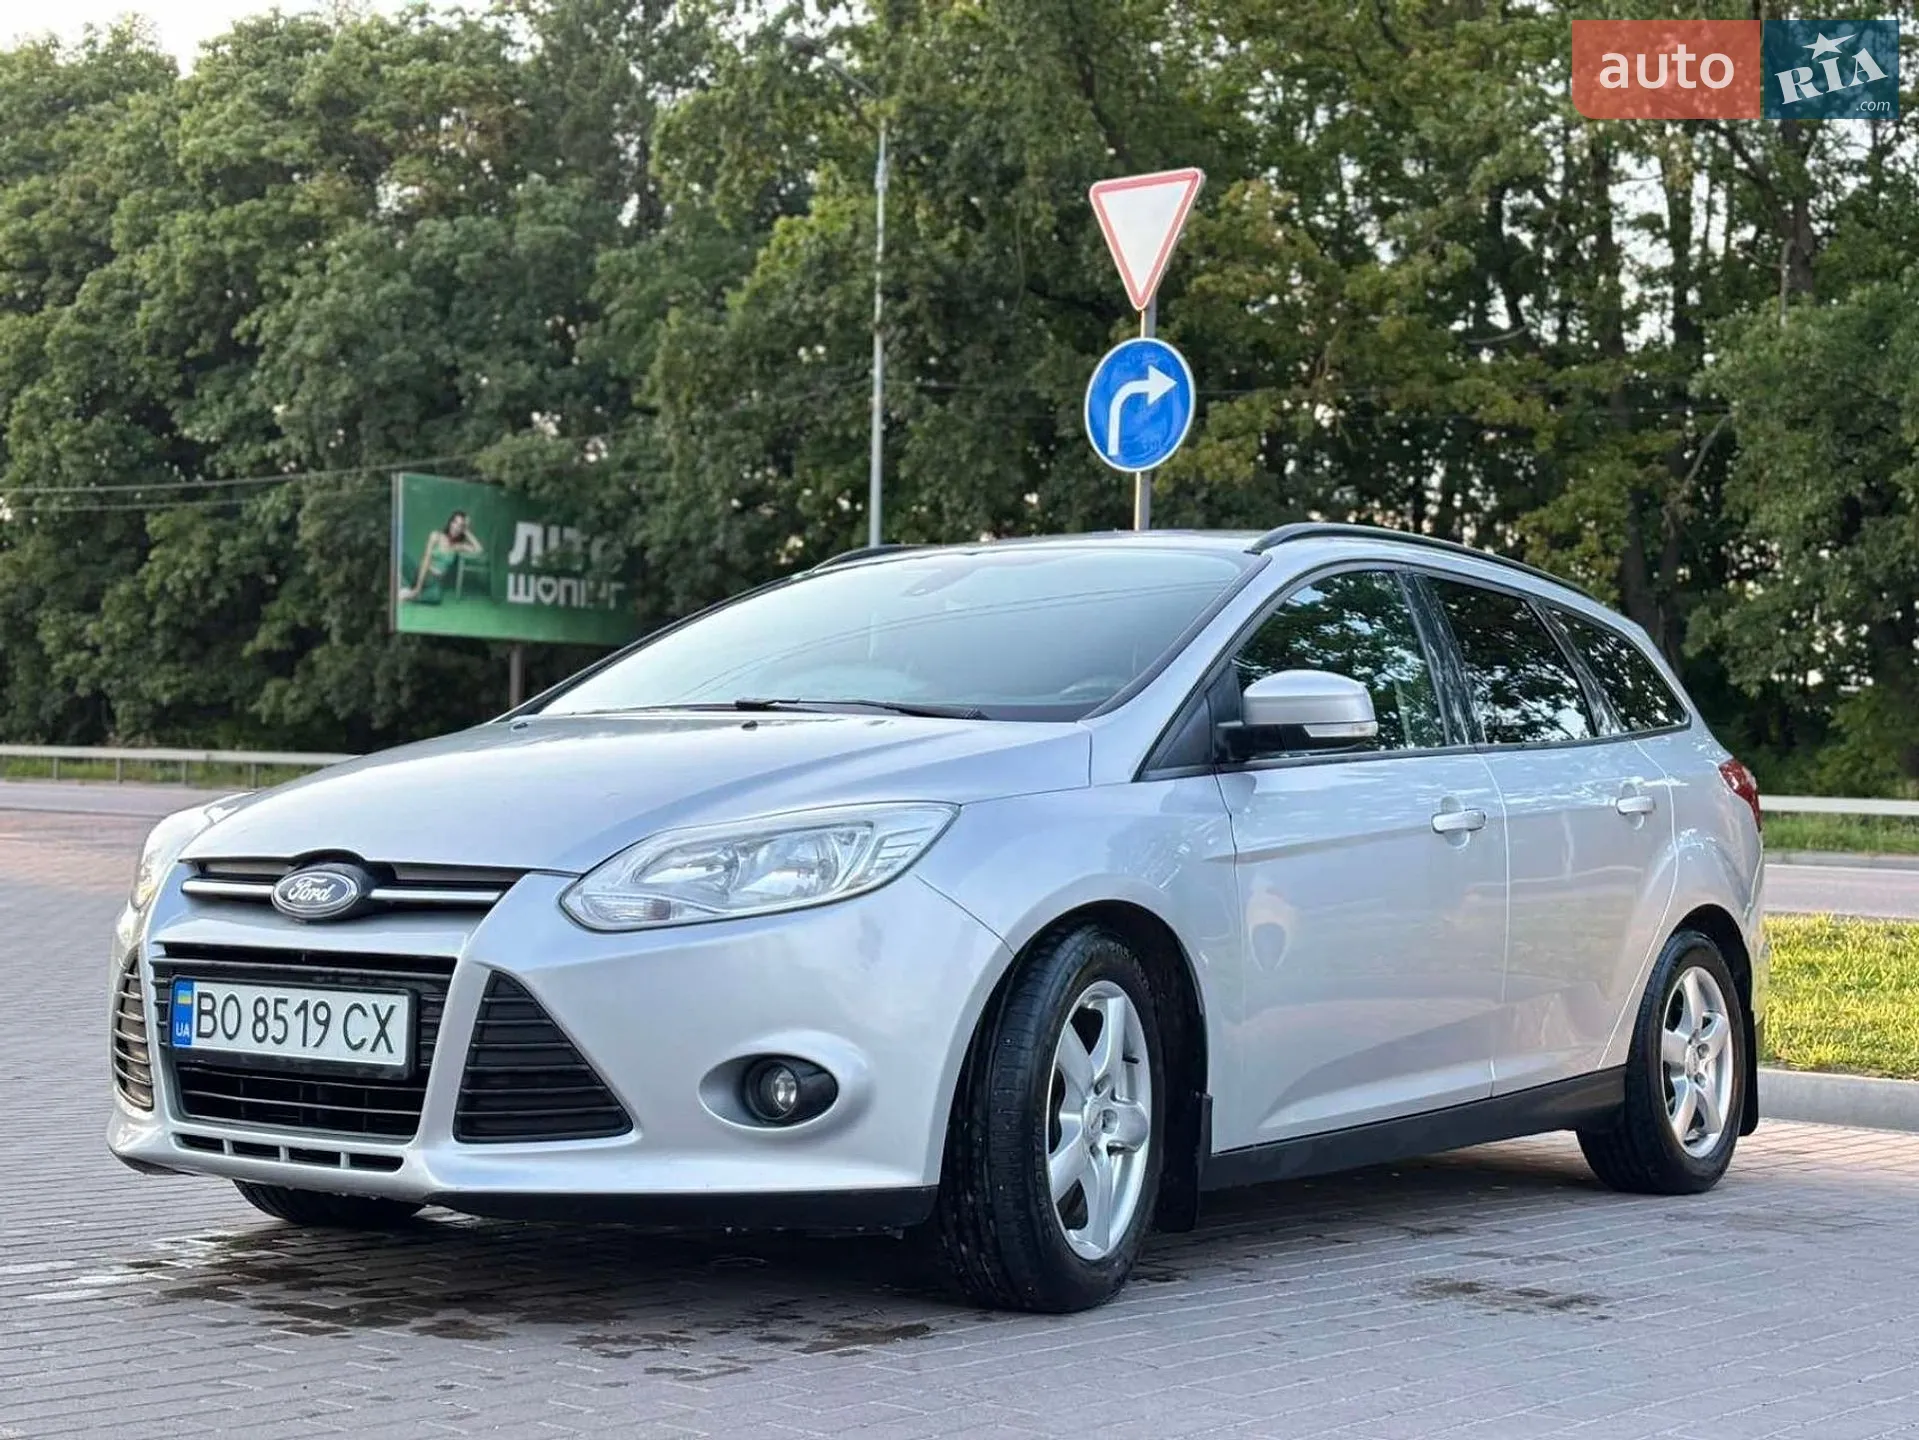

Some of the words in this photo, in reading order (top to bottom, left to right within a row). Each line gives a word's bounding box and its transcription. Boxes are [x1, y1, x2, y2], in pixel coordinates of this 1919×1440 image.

[287, 877, 336, 901] Ford
[175, 1022, 190, 1038] UA
[197, 991, 241, 1040] BO
[252, 996, 331, 1048] 8519
[343, 1002, 396, 1054] CX
